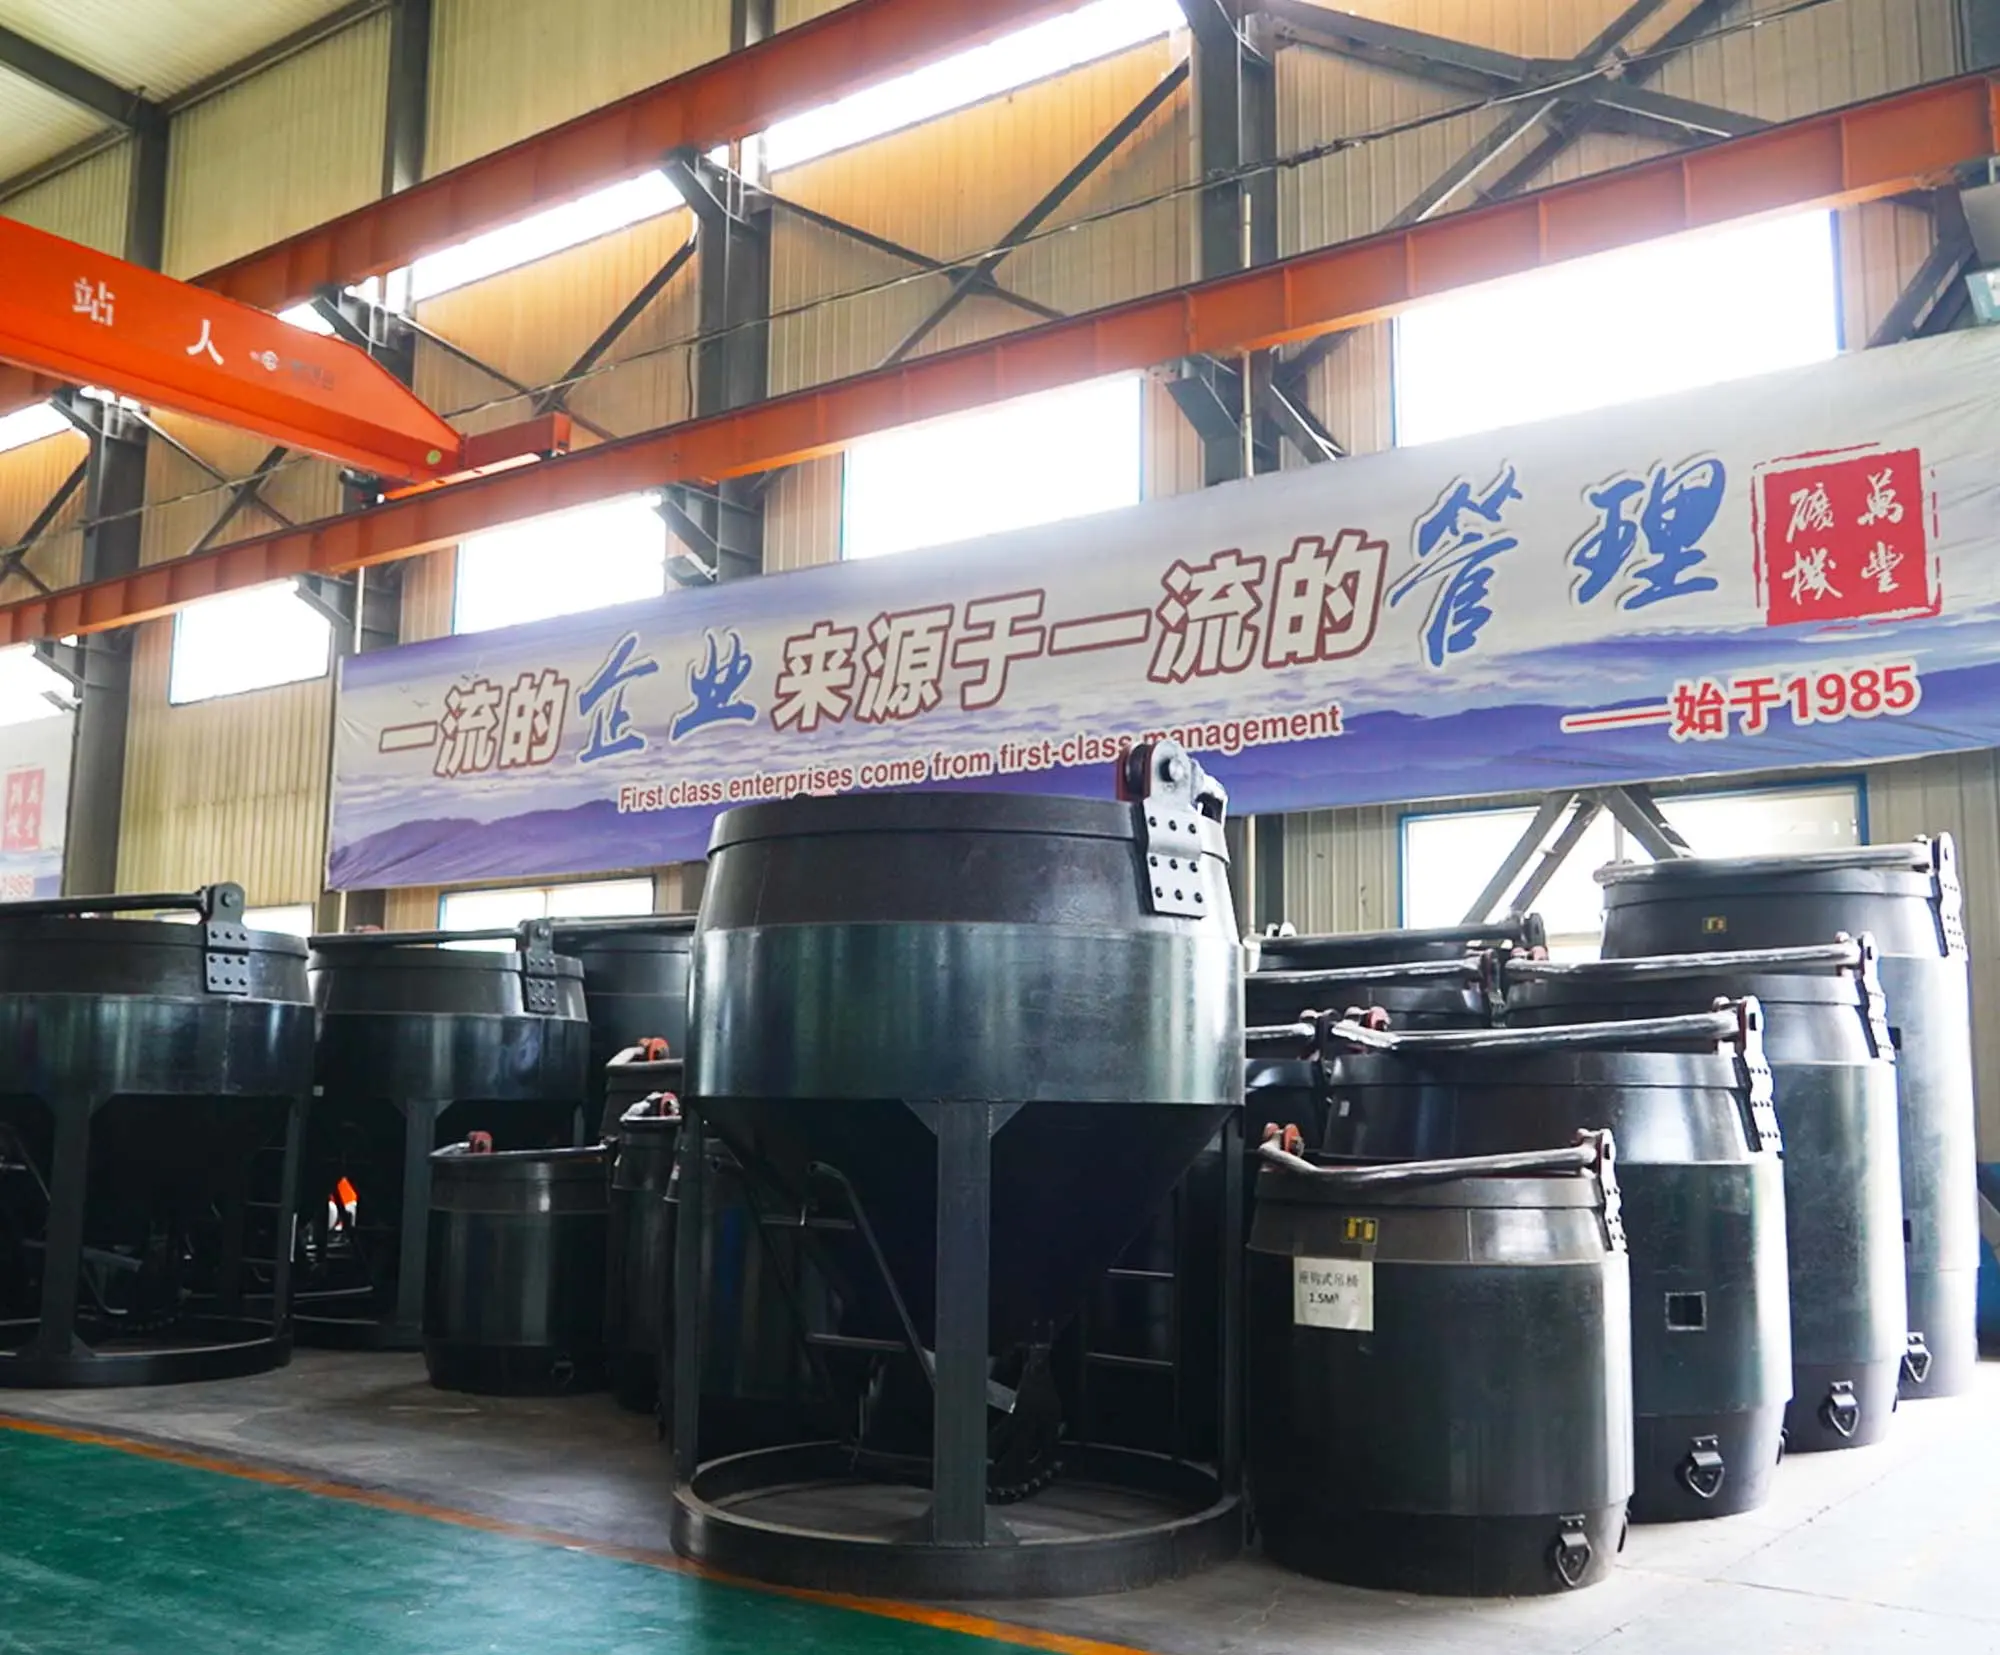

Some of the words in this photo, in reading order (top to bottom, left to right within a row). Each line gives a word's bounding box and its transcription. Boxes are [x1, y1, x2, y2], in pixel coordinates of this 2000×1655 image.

[378, 459, 1726, 778] 一流的企业来源于一流的管理
[619, 786, 664, 811] First
[669, 781, 723, 804] class
[729, 767, 853, 798] enterprises
[860, 759, 926, 785] come
[933, 751, 991, 776] from
